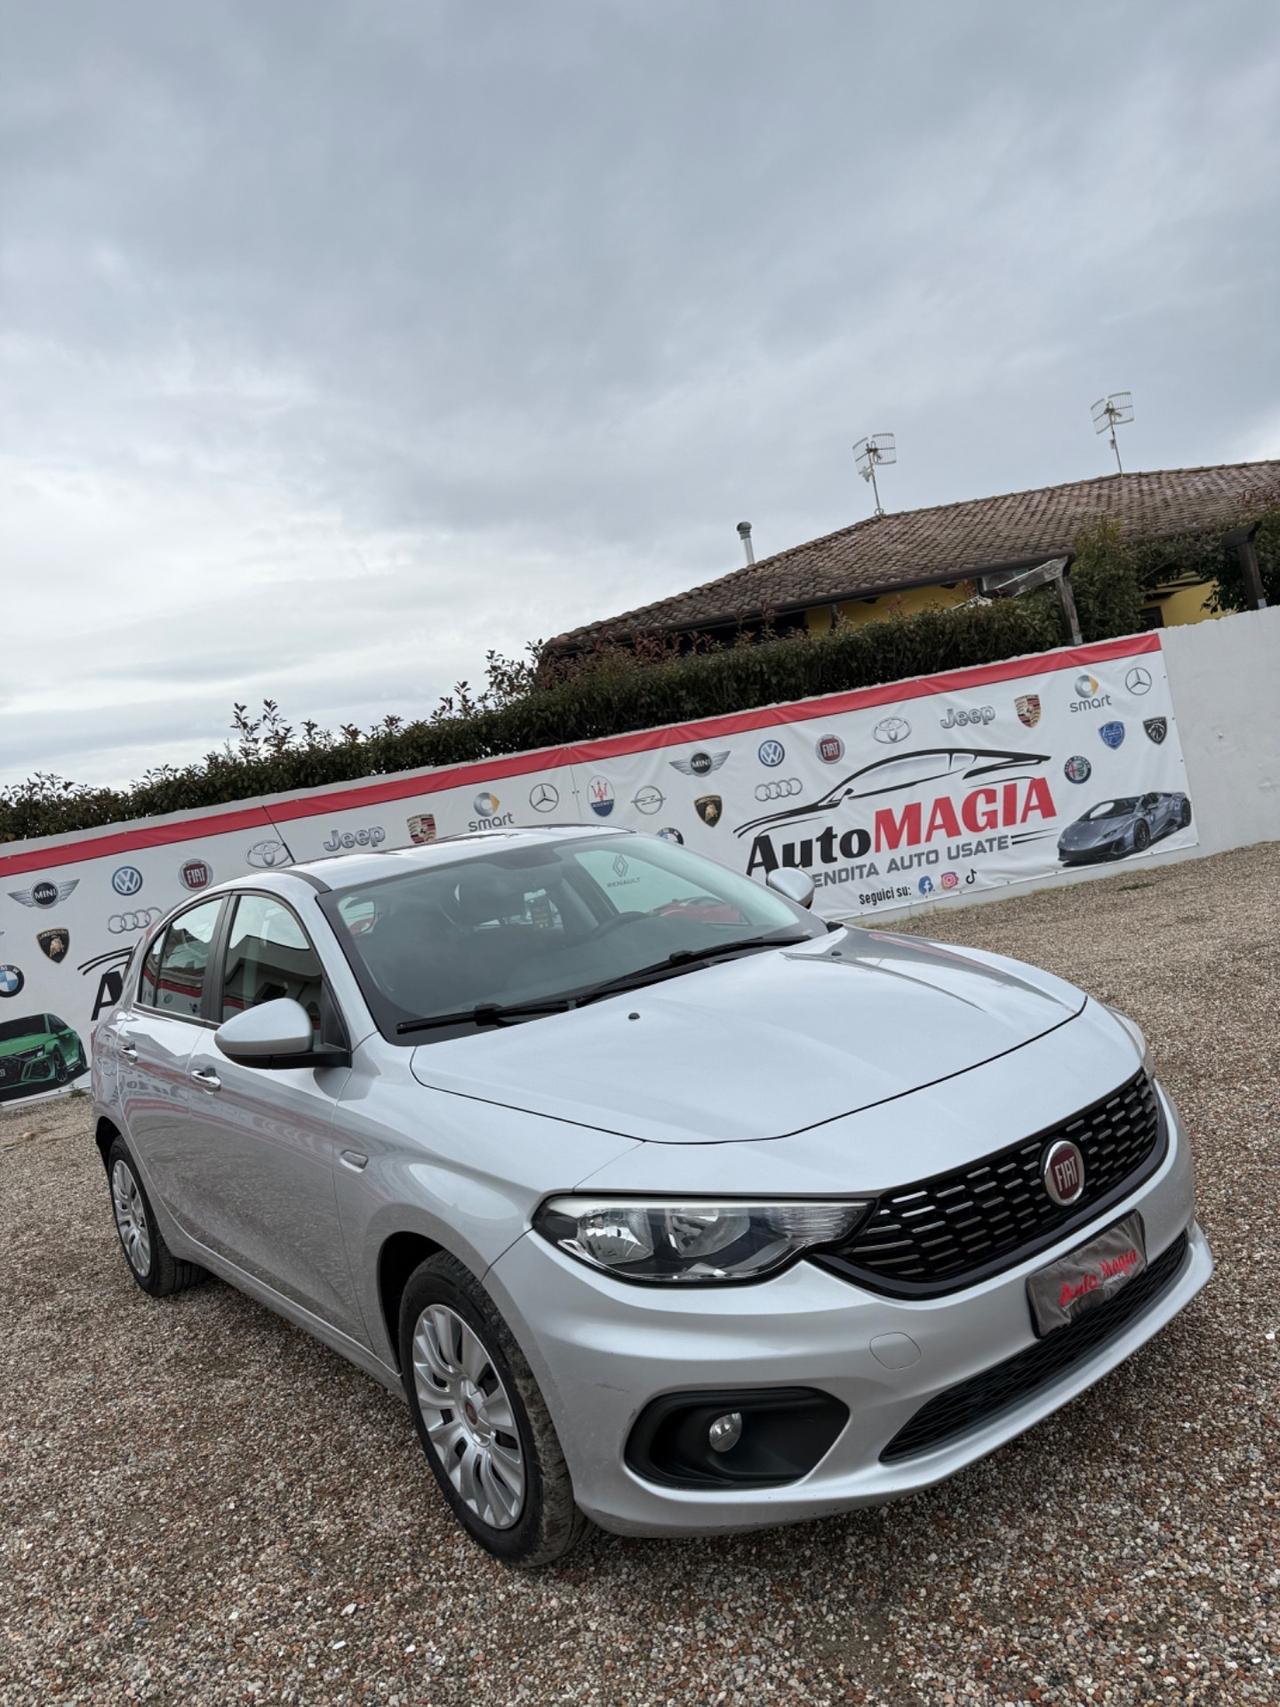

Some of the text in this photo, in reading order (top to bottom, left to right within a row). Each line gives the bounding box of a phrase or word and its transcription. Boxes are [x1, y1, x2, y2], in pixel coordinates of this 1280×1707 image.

[1069, 694, 1112, 713] smart
[939, 705, 997, 729] Jeep
[822, 743, 839, 757] FIAT
[691, 759, 711, 768] MINI
[468, 812, 514, 832] smart
[323, 826, 386, 851] Jeep
[812, 835, 1010, 888] ENDITA AUTO USATE
[186, 868, 205, 884] FIAT
[34, 888, 57, 899] MINI
[859, 886, 912, 906] Seguici su:
[1055, 1156, 1078, 1192] FIAT
[1058, 1273, 1098, 1307] Auto
